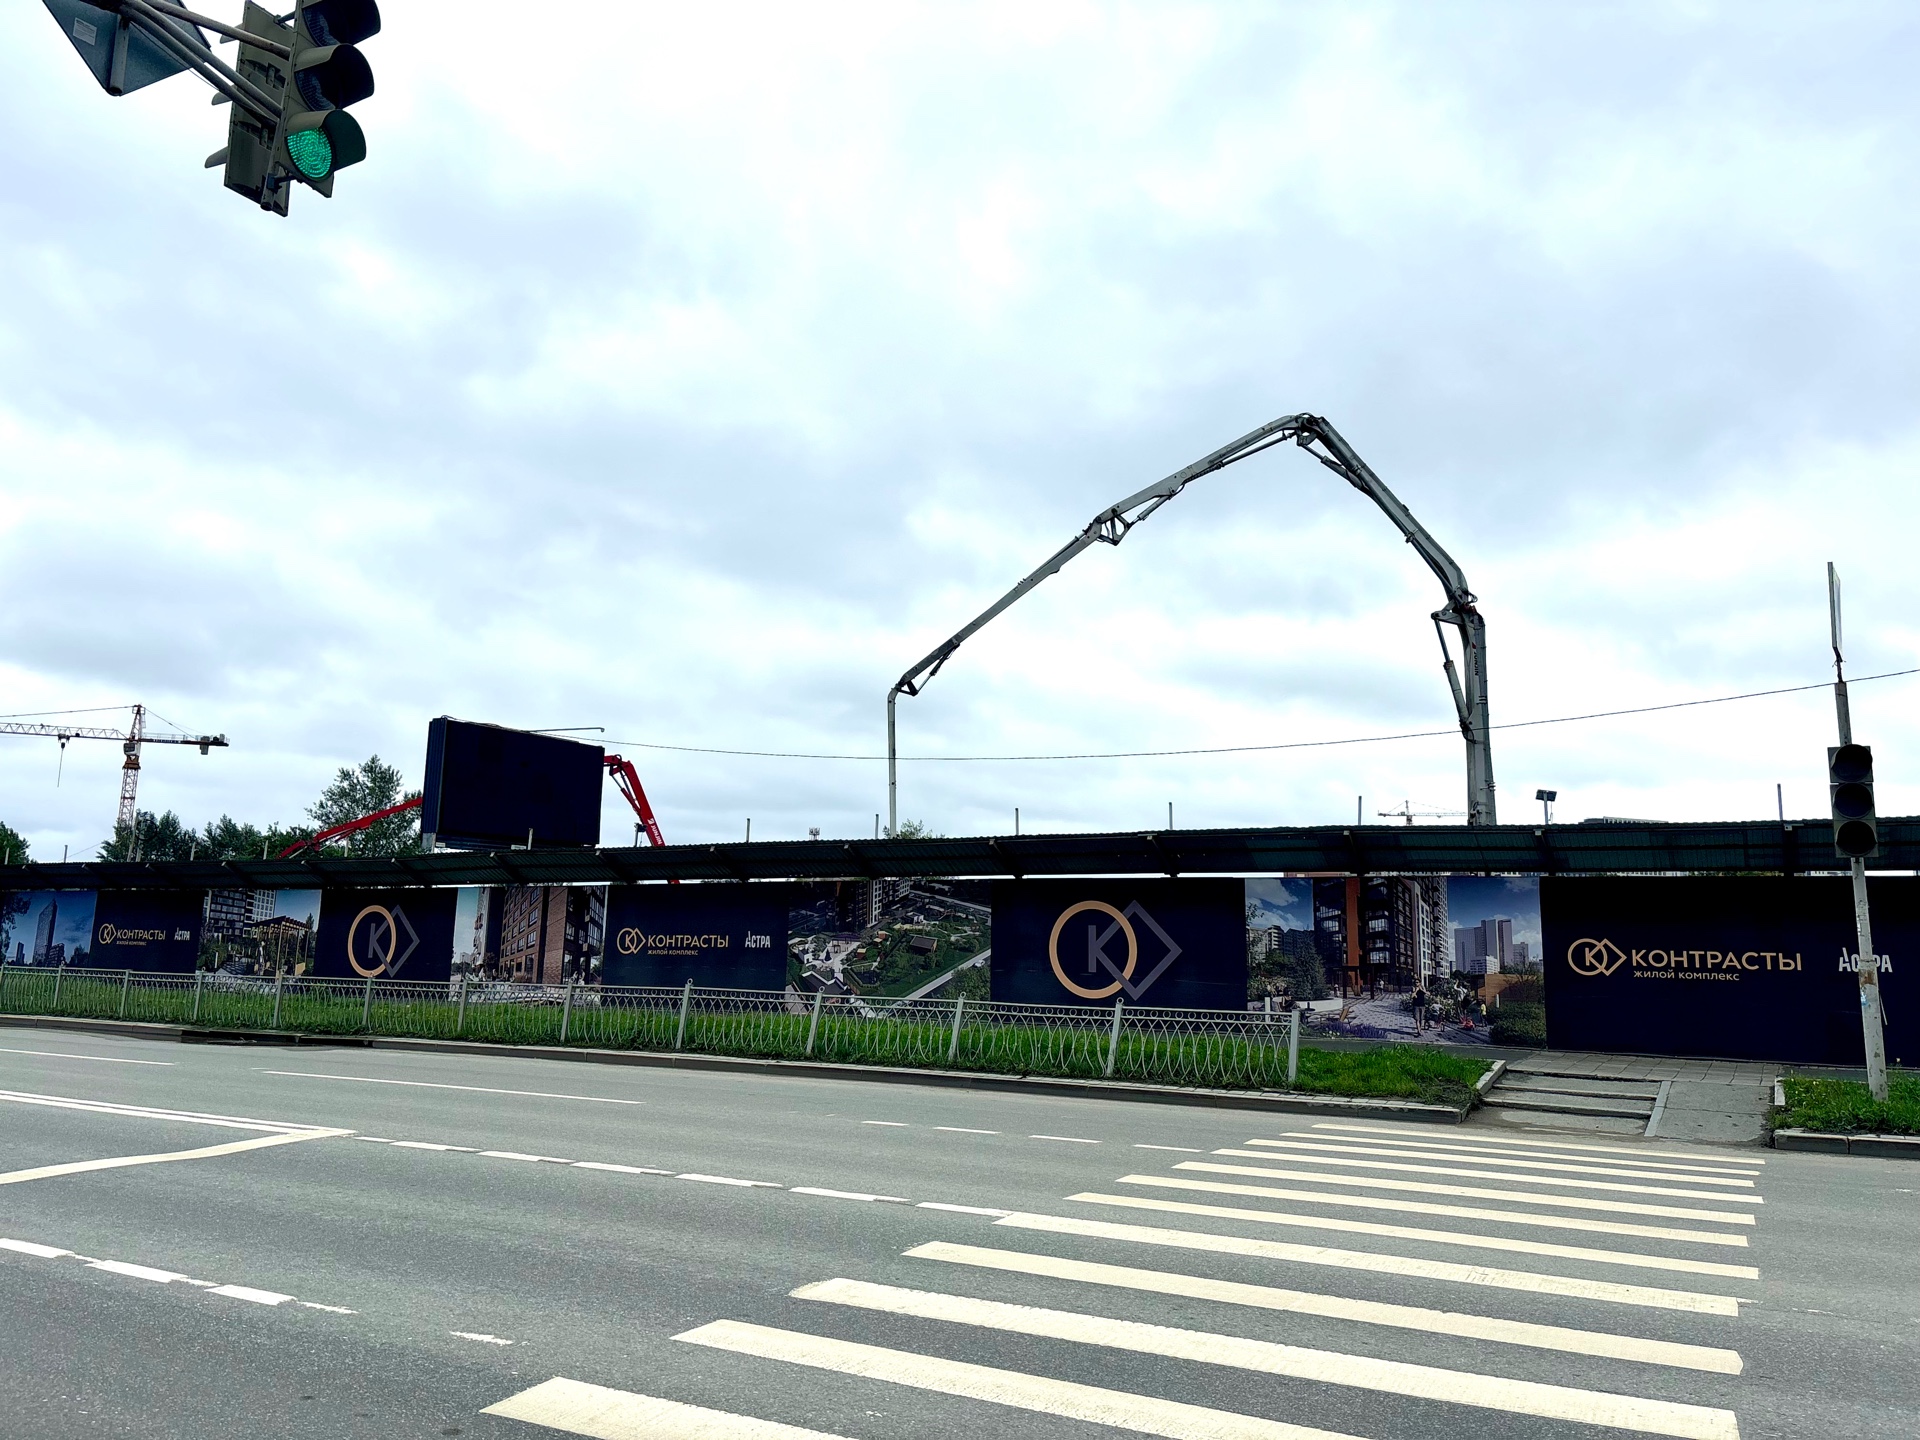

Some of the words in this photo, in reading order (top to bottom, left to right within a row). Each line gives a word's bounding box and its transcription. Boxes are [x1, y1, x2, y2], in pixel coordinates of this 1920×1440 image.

[117, 929, 166, 940] КОНТРАСТЫ
[647, 934, 729, 948] КОНТРАСТЫ
[744, 931, 771, 948] АСТРА
[1631, 949, 1802, 971] КОНТРАСТЫ
[1633, 969, 1675, 979] жилой
[1678, 971, 1740, 981] комплекс
